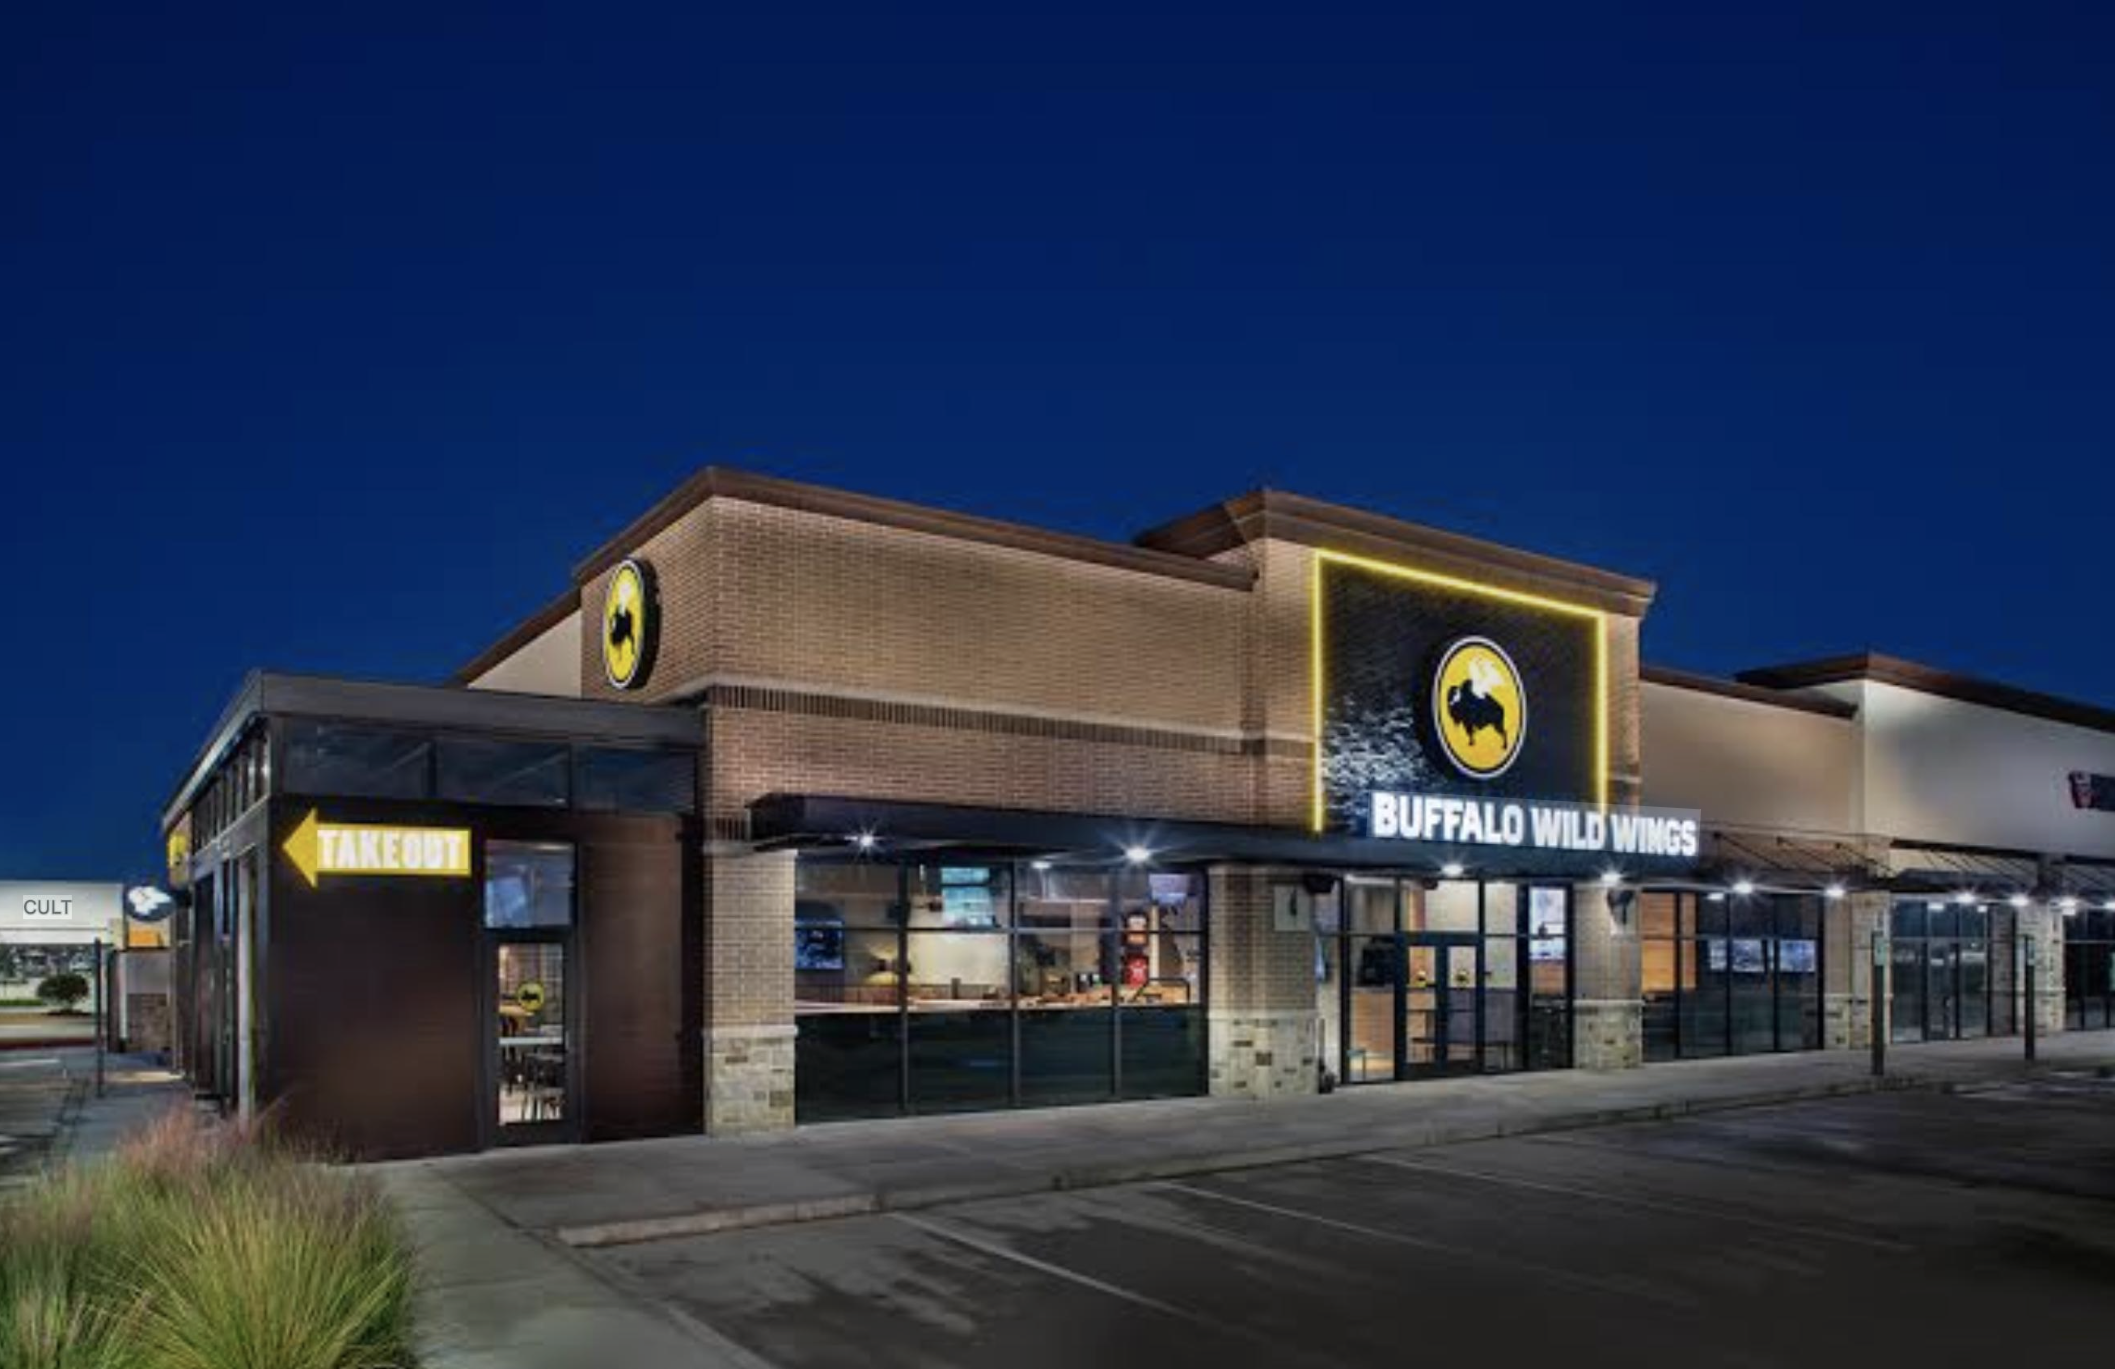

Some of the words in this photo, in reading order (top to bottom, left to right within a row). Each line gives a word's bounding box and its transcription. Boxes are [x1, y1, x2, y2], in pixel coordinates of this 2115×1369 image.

[1372, 791, 1524, 846] BUFFALO
[1530, 806, 1606, 851] WILD
[1610, 814, 1697, 857] WINGS
[317, 829, 461, 869] TAKEOUT
[23, 899, 72, 915] CULT
